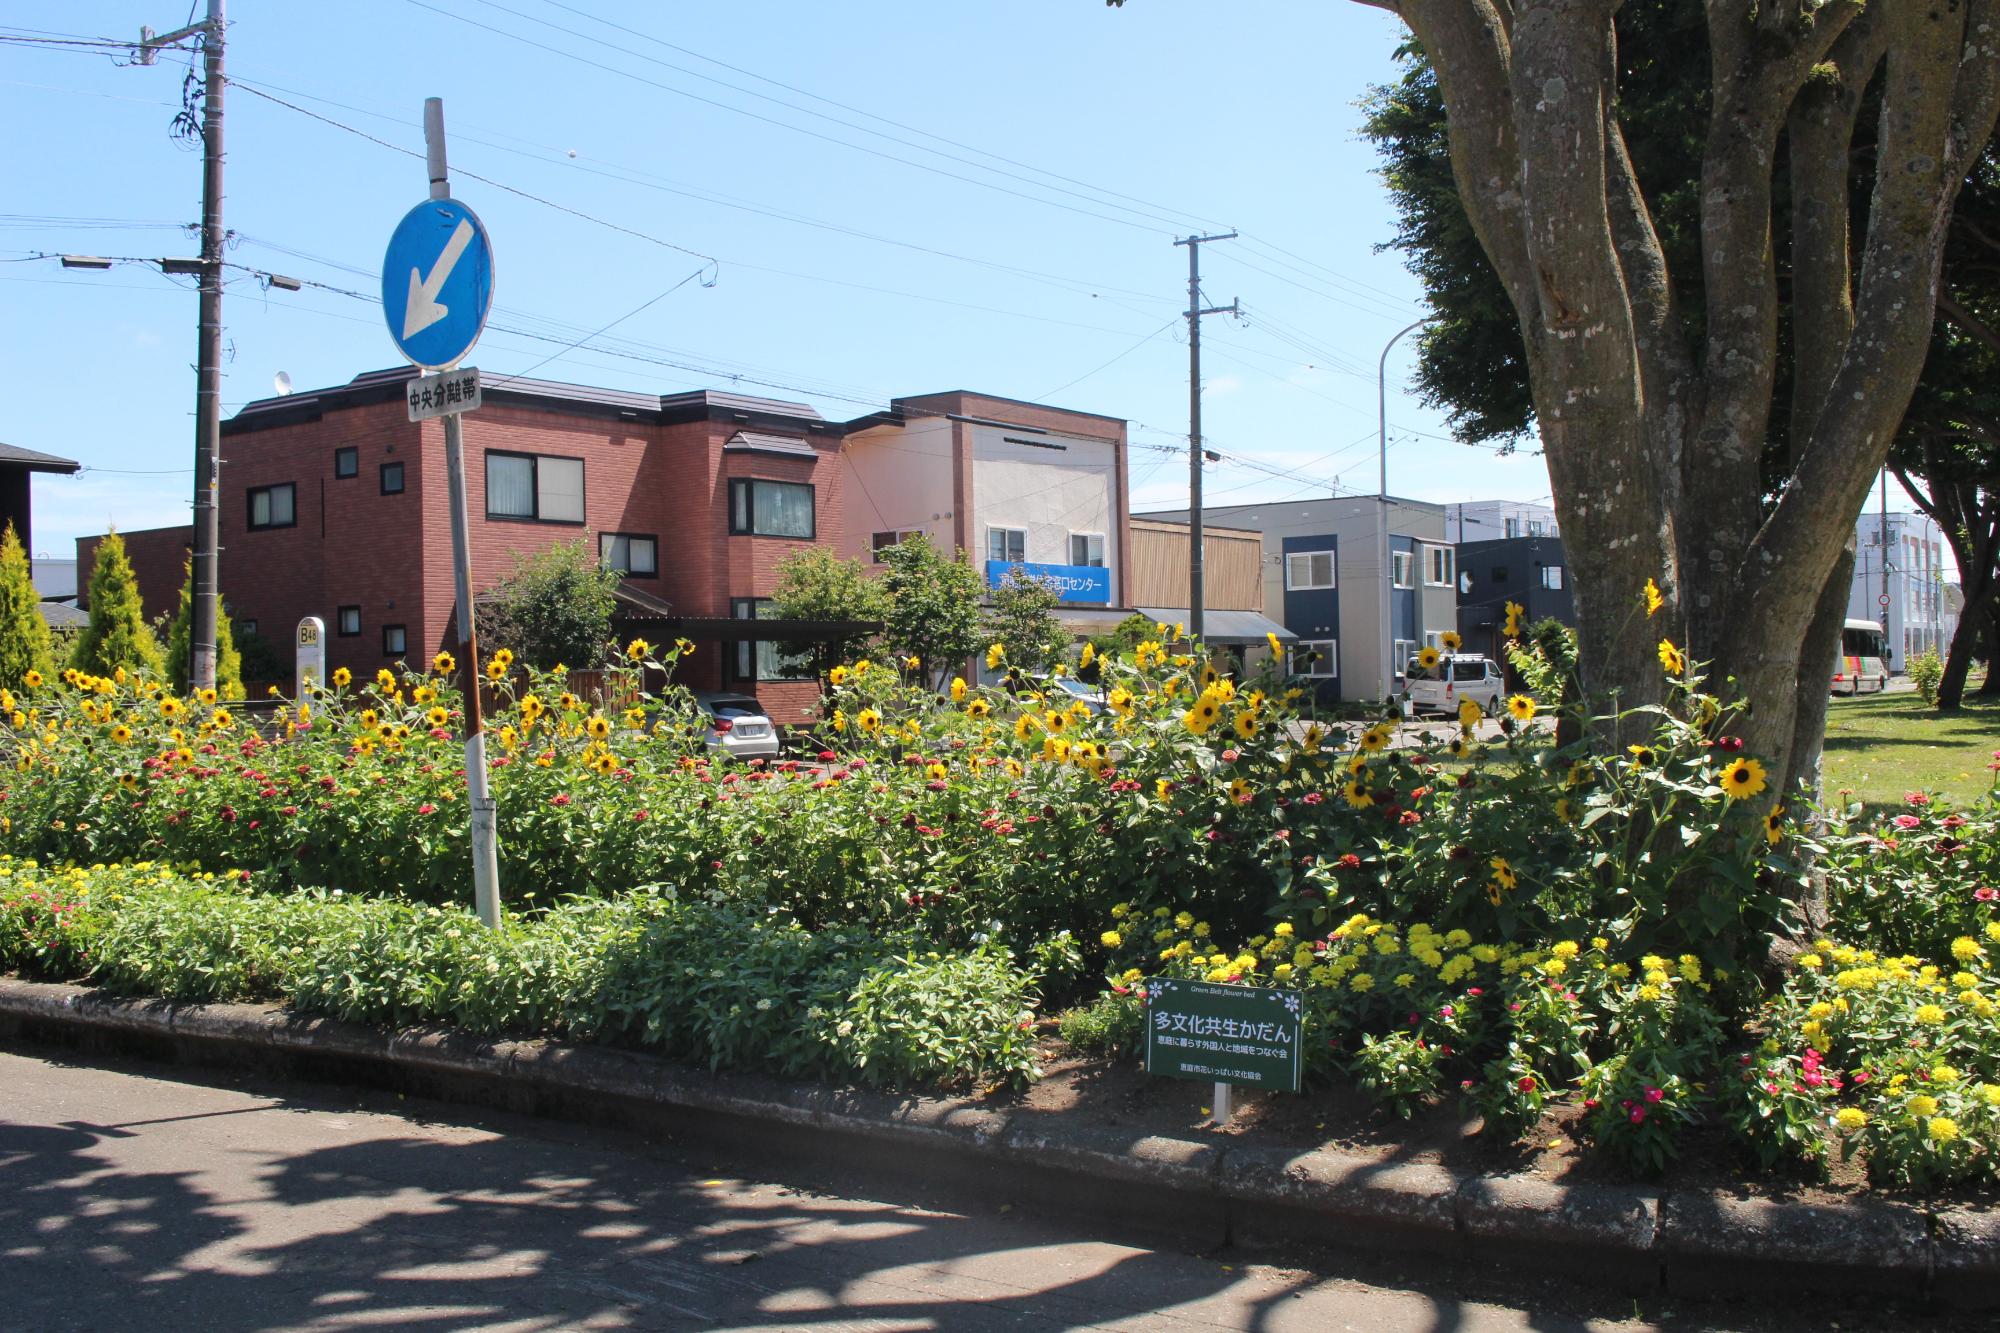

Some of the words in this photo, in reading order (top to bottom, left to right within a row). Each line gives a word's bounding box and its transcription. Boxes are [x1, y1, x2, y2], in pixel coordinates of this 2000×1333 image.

[410, 376, 475, 412] 中央分離帯
[301, 627, 316, 642] B48
[1190, 985, 1209, 994] Green
[1222, 988, 1242, 997] flower
[1243, 990, 1256, 998] bed
[1154, 1011, 1291, 1043] 多文化共生かだん
[1157, 1034, 1288, 1059] 恵庭に暮らす外国人と地域をつなぐ会
[1180, 1063, 1262, 1081] 恵庭市花いっぱい文化協会
